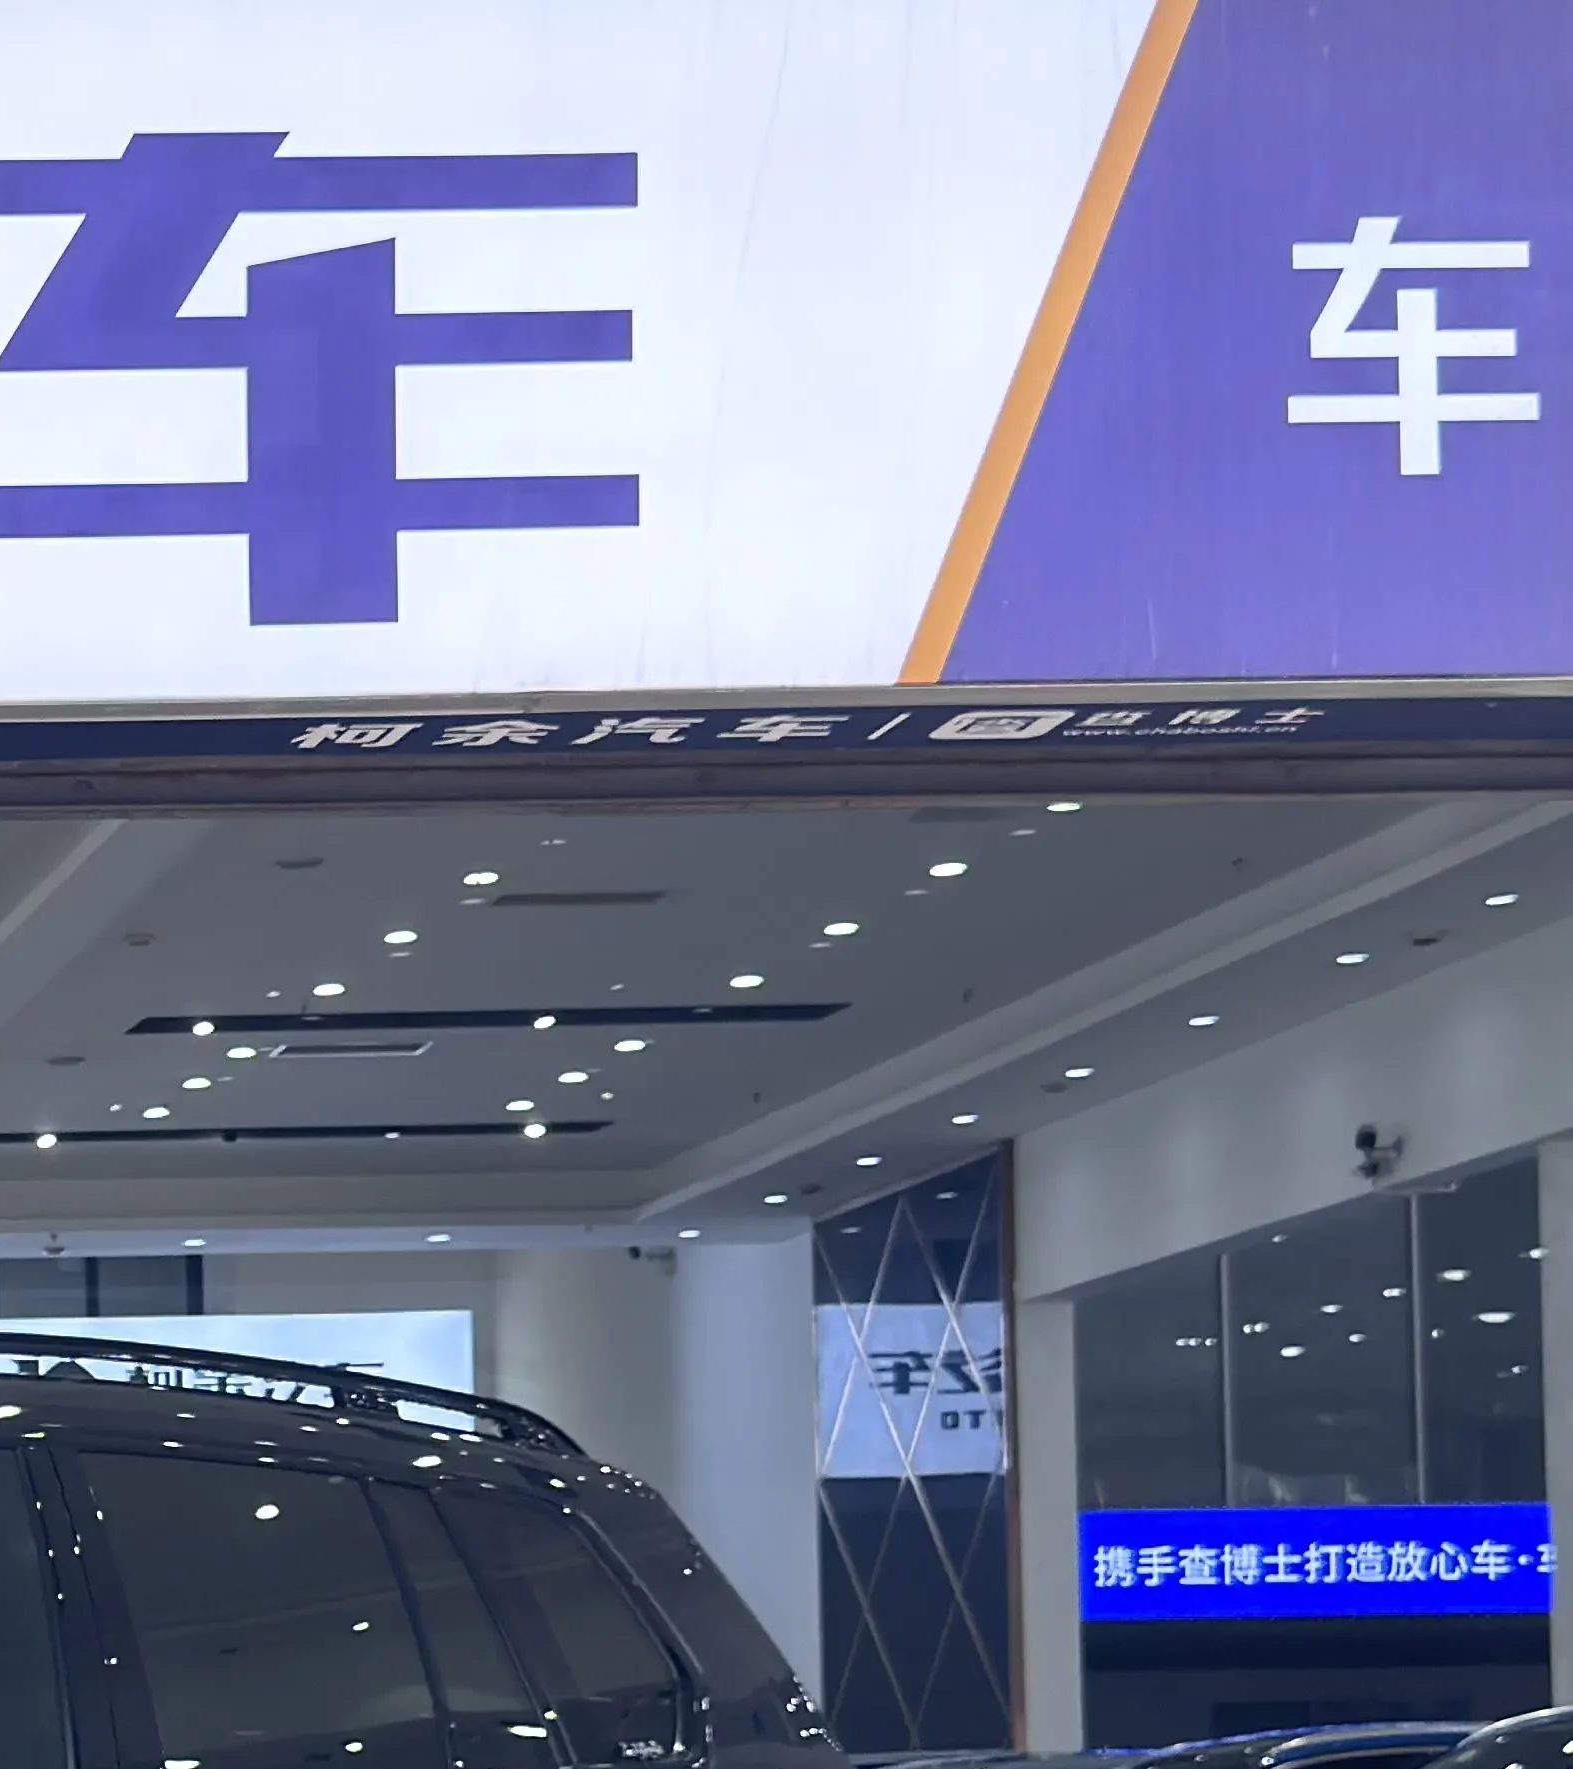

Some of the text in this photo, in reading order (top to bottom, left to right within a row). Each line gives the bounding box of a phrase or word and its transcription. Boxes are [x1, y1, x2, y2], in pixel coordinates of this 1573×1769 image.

[1288, 216, 1541, 476] 车
[290, 714, 851, 749] 柯余汽车
